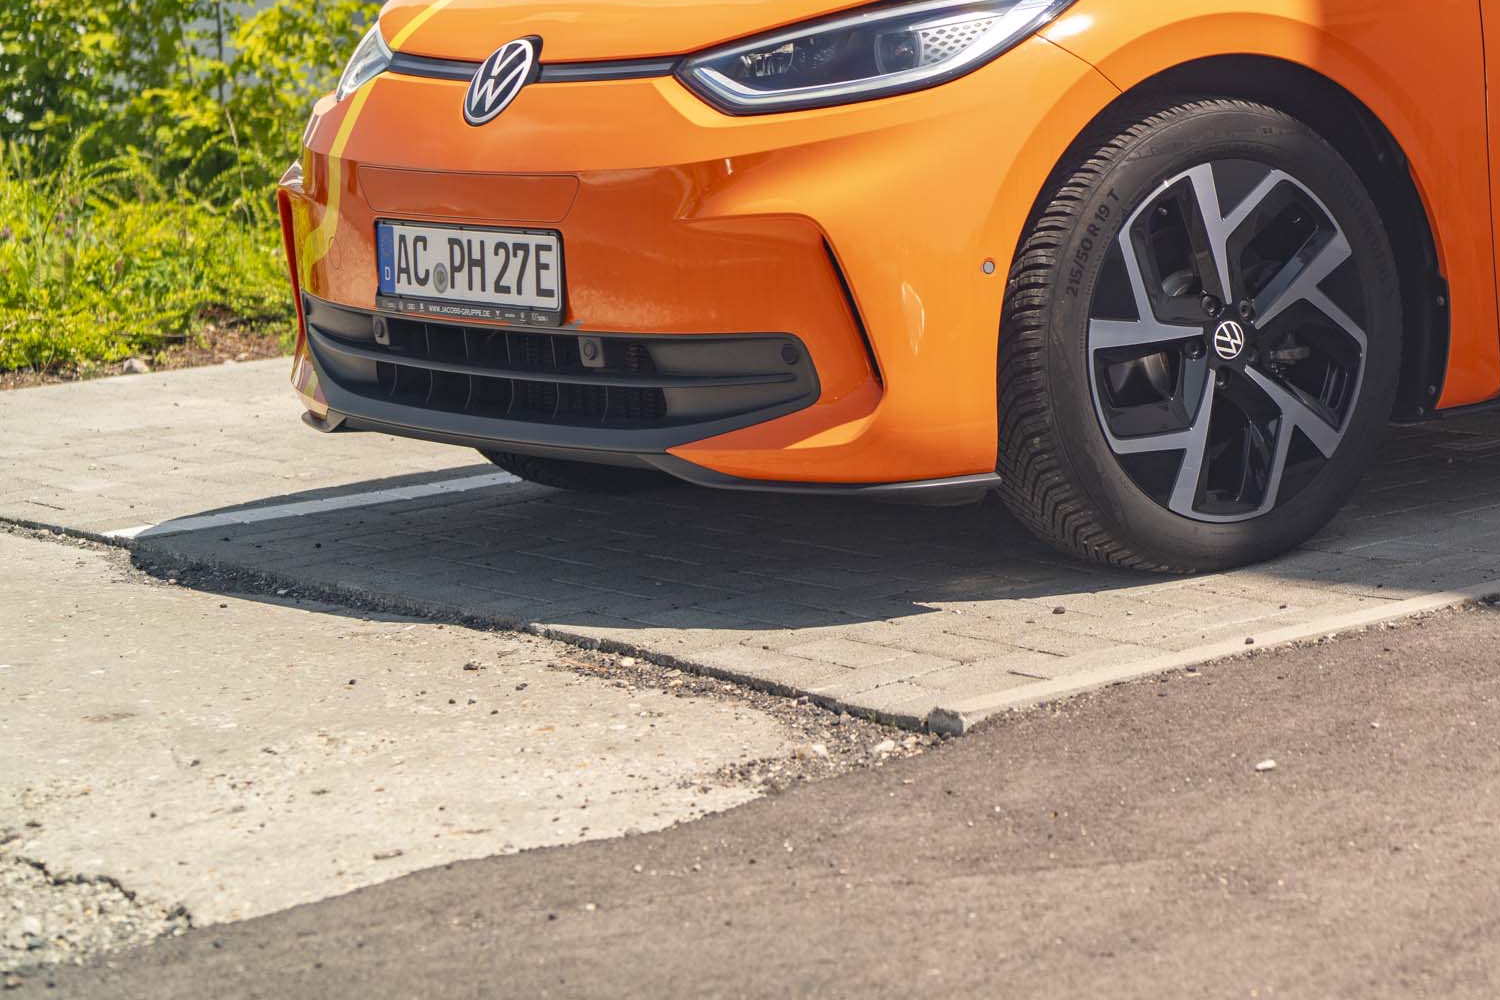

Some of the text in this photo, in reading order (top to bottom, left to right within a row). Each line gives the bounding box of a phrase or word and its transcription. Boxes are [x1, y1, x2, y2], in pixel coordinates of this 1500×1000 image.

[465, 40, 533, 122] VW
[384, 266, 391, 281] D
[396, 234, 555, 298] AC PH 27E
[1066, 187, 1120, 297] 215/50 R 19 T
